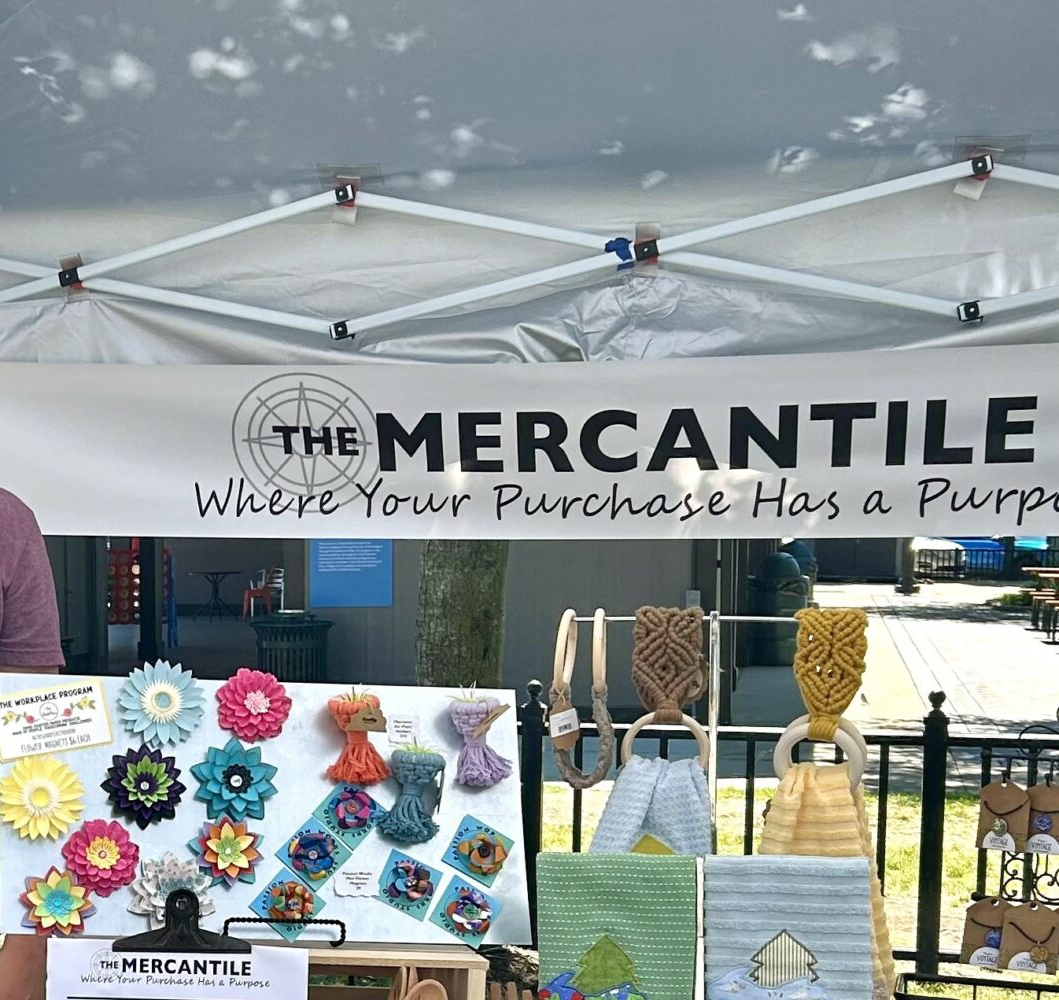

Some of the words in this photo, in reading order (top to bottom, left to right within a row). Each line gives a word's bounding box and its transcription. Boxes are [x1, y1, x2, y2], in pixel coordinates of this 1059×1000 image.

[272, 426, 359, 456] THE
[375, 395, 1038, 472] MERCANTILE
[195, 477, 339, 519] Where
[355, 477, 471, 519] Your
[493, 482, 731, 521] Purchase
[753, 477, 840, 520] Has
[863, 489, 892, 515] a
[0, 700, 13, 709] THE
[15, 693, 57, 706] WORKPLACE
[59, 686, 93, 698] PROGRAM
[21, 743, 42, 753] FLOWER
[100, 960, 119, 970] THE
[122, 958, 252, 977] MERCANTILE
[80, 974, 113, 984] Where
[116, 974, 142, 984] Your
[146, 975, 194, 986] Purchase
[197, 977, 215, 987] Has
[228, 978, 271, 989] Purpose
